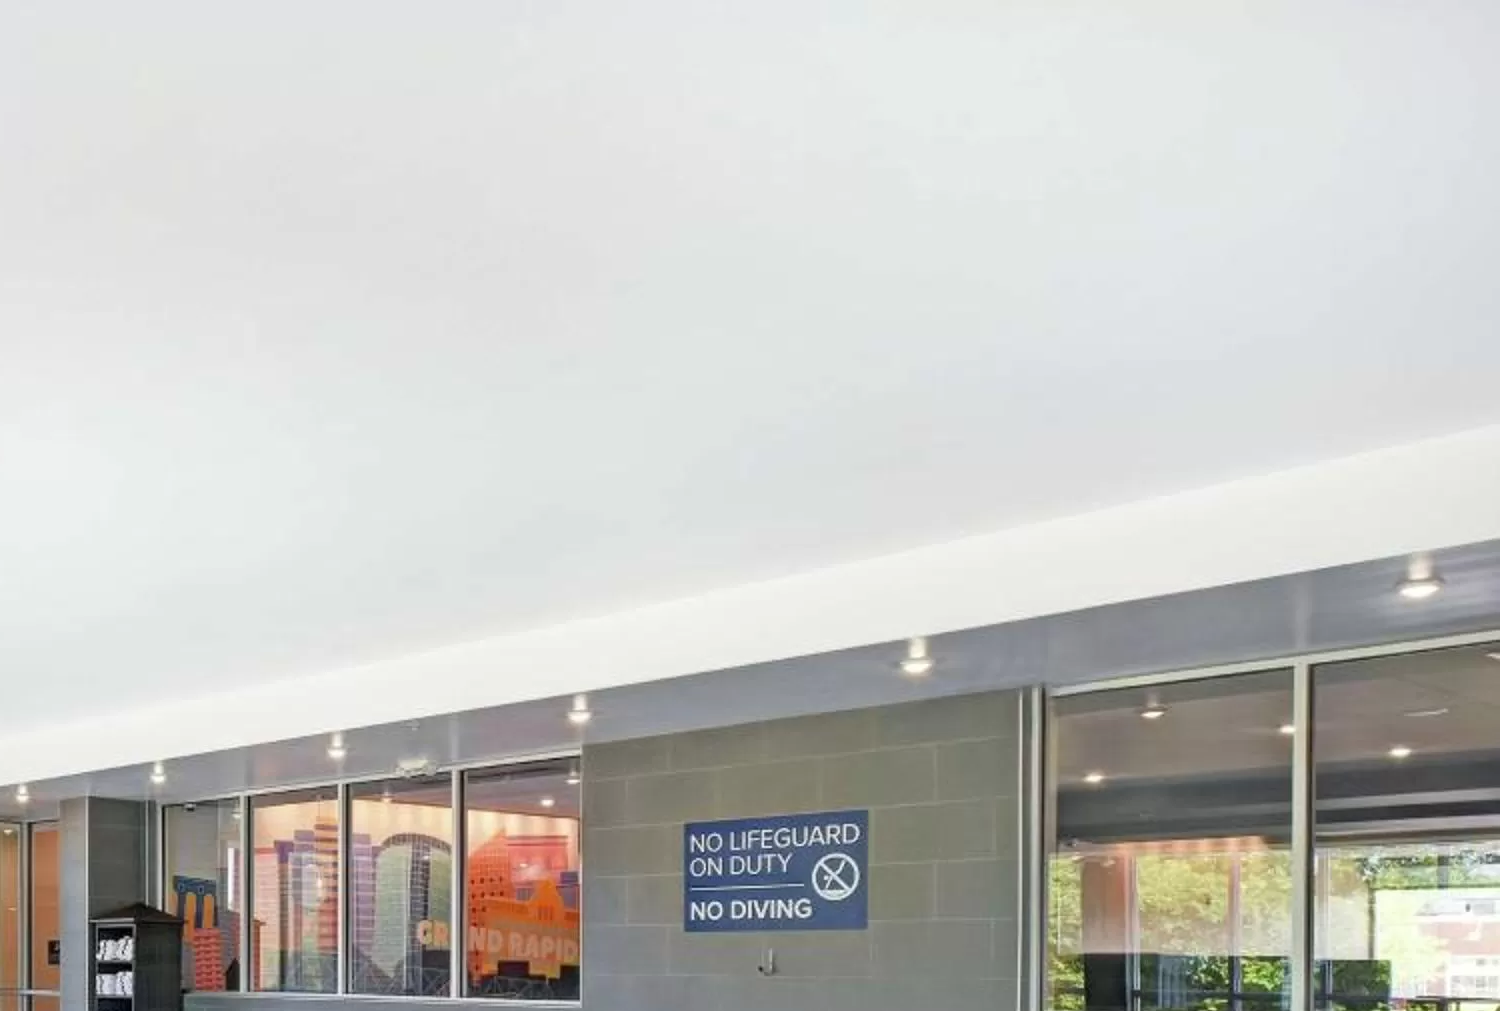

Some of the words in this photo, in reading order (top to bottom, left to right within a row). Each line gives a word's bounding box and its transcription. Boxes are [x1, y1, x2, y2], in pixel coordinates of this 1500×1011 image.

[689, 832, 723, 853] NO
[730, 823, 861, 851] LIFEGUARD
[689, 856, 723, 877] ON
[730, 852, 792, 876] DUTY
[690, 901, 723, 921] NO
[731, 898, 813, 920] DIVING
[417, 919, 504, 953] GRND
[508, 931, 579, 961] RAPID
